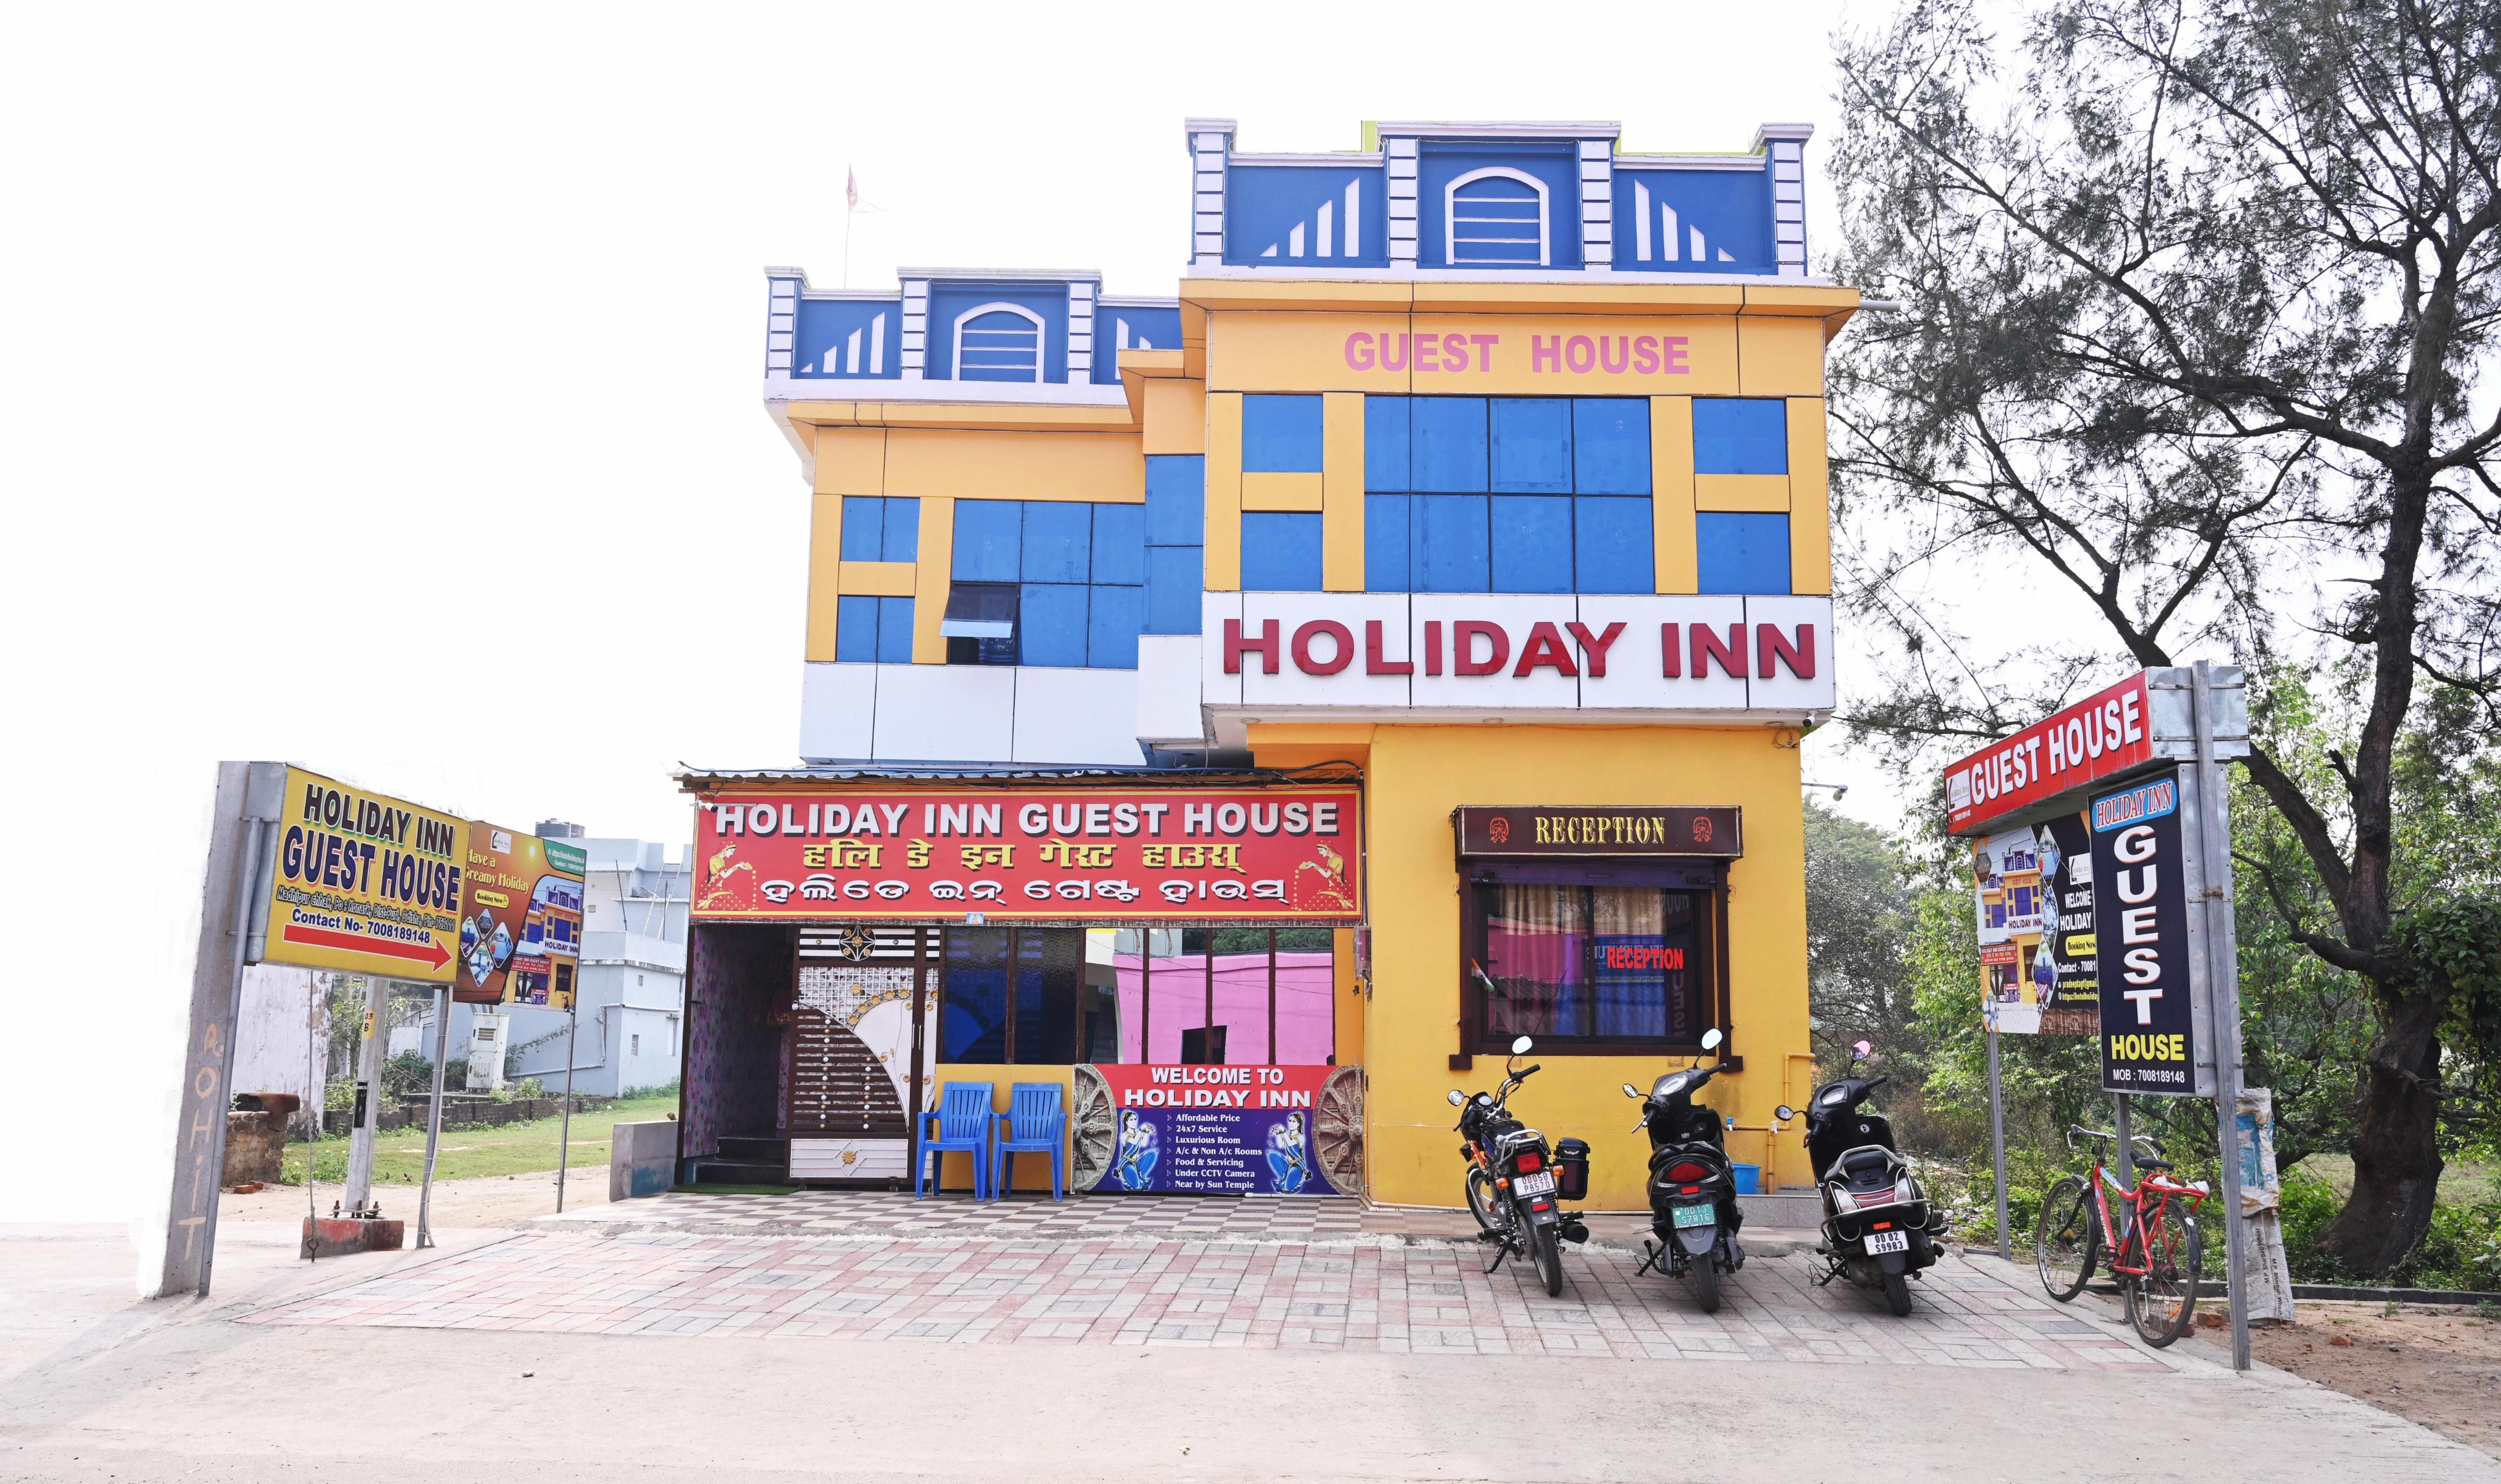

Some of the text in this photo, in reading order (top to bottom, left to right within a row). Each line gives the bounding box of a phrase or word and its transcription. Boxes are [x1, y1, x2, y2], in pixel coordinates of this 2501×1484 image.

[1344, 332, 1690, 375] GUEST HOUSE
[1223, 618, 1815, 680] HOLIDAY INN
[1971, 689, 2142, 805] GUEST HOUSE
[2096, 782, 2172, 827] HOLIDAY INN
[303, 783, 454, 858] HOLIDAY INN
[716, 802, 1337, 834] HOLIDAY INN GUEST HOUSE
[1535, 816, 1665, 844] RECEPTION
[490, 858, 496, 868] a
[803, 838, 883, 868] हलि
[907, 838, 933, 867] डे
[960, 844, 1015, 870] इन
[283, 825, 462, 912] GUEST HOUSE
[499, 873, 530, 895] Holiday
[277, 886, 310, 905] Madhipur
[311, 892, 333, 910] chhak,
[335, 897, 343, 910] Po
[348, 899, 372, 917] Konark,
[402, 910, 423, 927] Odisha,
[477, 893, 494, 903] Booking
[2065, 890, 2091, 909] WELCOME
[292, 908, 430, 943] Contact No- 7008189148
[2009, 918, 2042, 929] HOLIDAY INN
[2059, 912, 2091, 932] HOLIDAY
[2114, 825, 2163, 1024] GUEST
[545, 940, 568, 951] HOLIDAY
[2067, 942, 2085, 951] Booking
[1607, 947, 1683, 969] RECEPTION
[2058, 962, 2077, 973] Contact
[2081, 960, 2098, 972] 70081
[364, 1023, 369, 1032] B
[2111, 1034, 2185, 1061] HOUSE
[1152, 1067, 1284, 1084] WELCOME TO
[2113, 1069, 2131, 1080] MOB
[2138, 1069, 2185, 1083] 7008189148
[1125, 1089, 1311, 1107] HOLIDAY INN
[1175, 1136, 1215, 1144] Luxurious
[1175, 1147, 1189, 1155] A/c
[1207, 1158, 1244, 1168] Servicing
[1195, 1181, 1205, 1189] by
[1225, 1181, 1254, 1190] Temple
[1524, 1181, 1550, 1193] P8570
[1682, 1213, 1710, 1223] S7816
[1875, 1241, 1903, 1252] S9983
